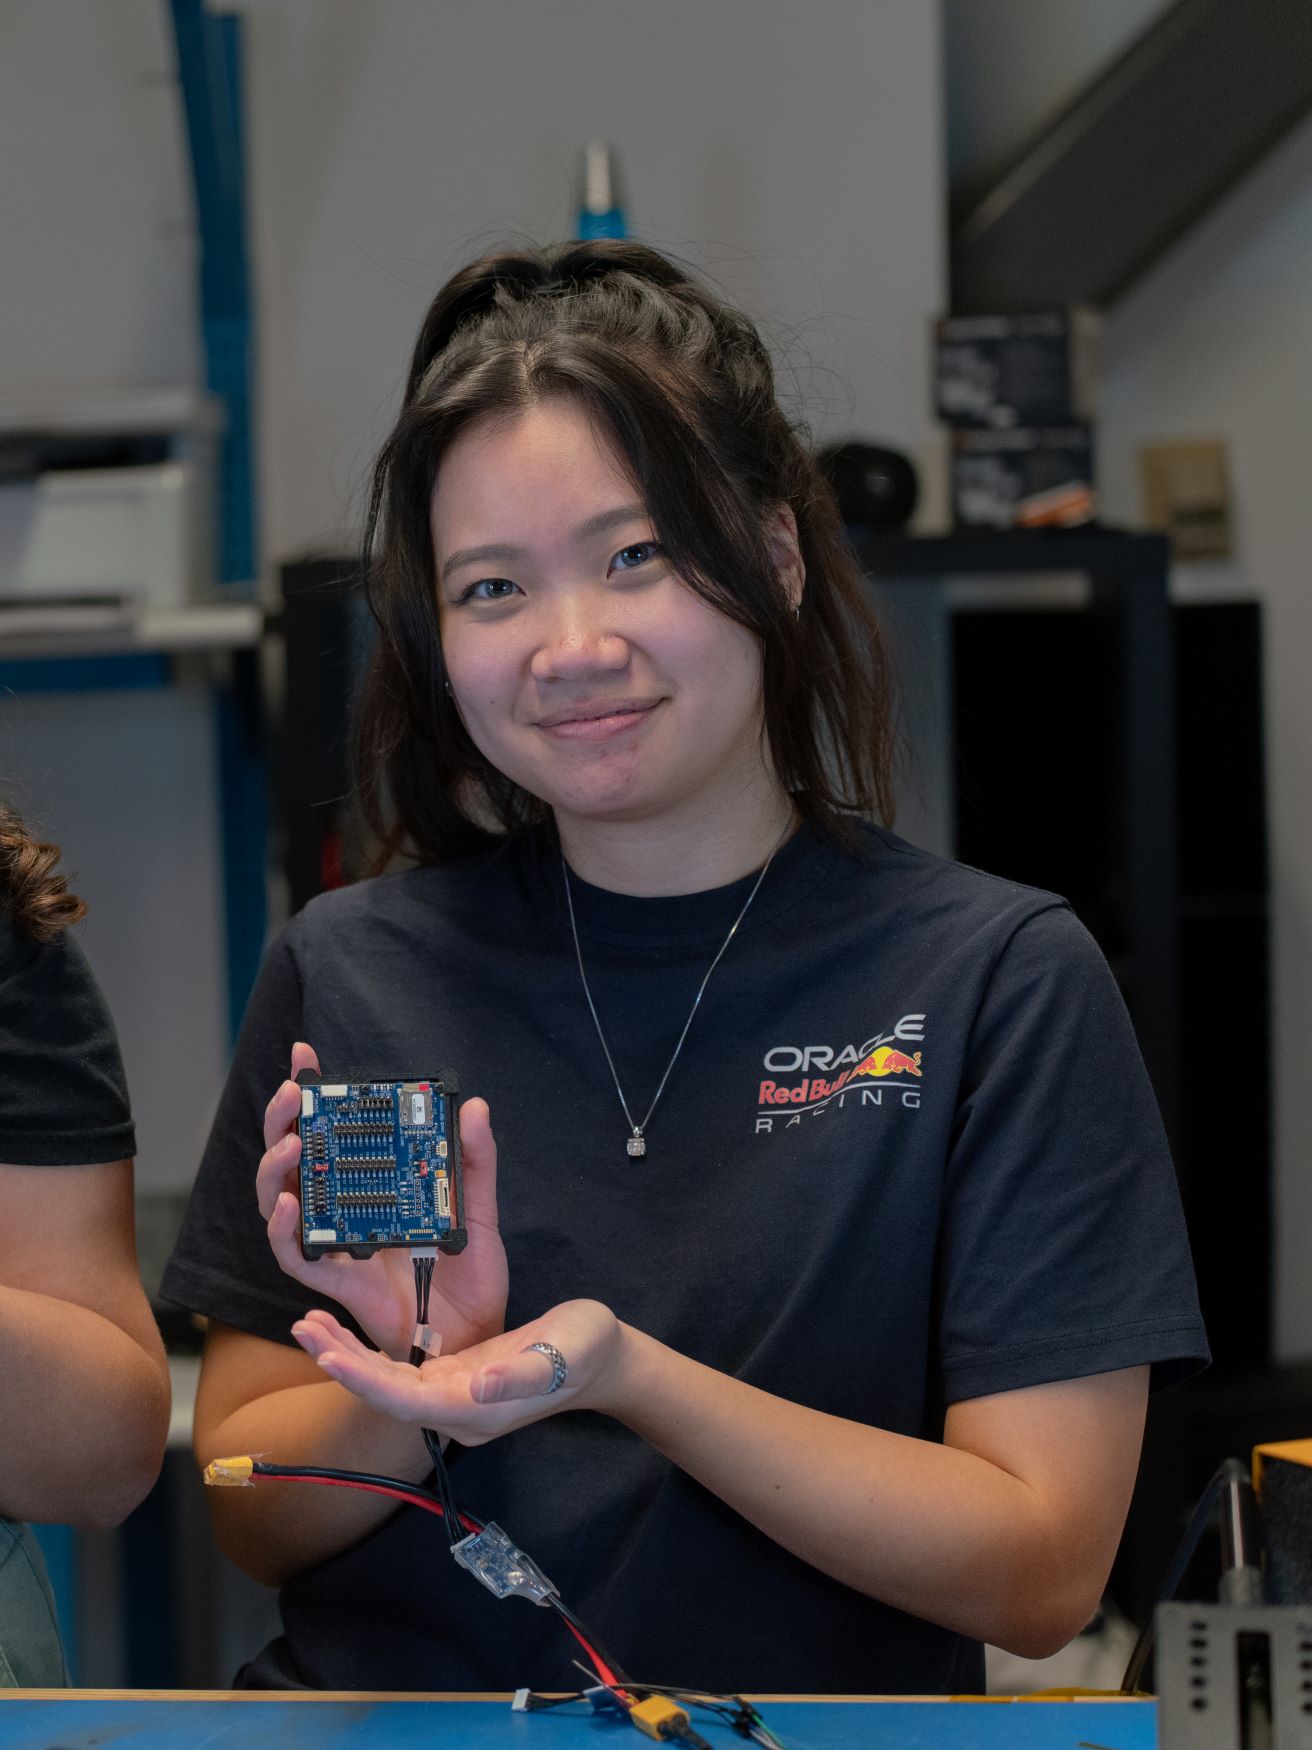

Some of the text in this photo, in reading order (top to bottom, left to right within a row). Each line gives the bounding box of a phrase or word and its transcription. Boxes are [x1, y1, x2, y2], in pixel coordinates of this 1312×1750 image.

[763, 1013, 927, 1072] ORACLE
[755, 1089, 921, 1134] RACING
[758, 1079, 809, 1105] Red
